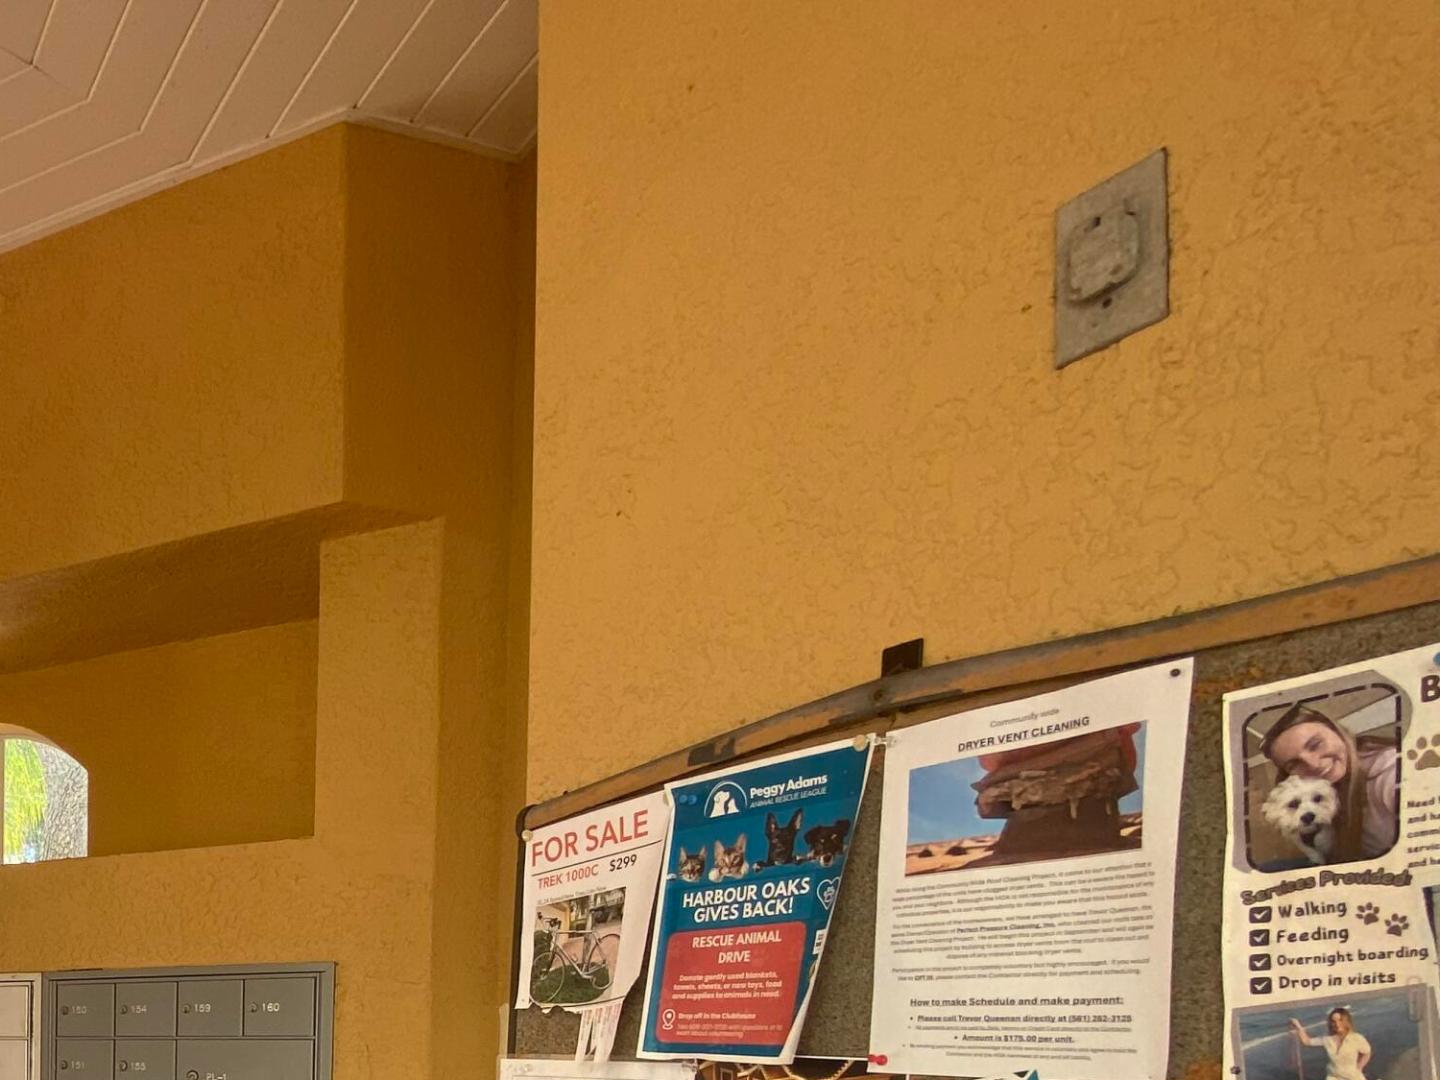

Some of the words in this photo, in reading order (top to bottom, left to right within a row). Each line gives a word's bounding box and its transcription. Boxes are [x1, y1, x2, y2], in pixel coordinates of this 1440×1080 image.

[958, 736, 995, 753] DRYER
[996, 730, 1028, 745] VENT
[1031, 716, 1090, 738] CLEANING
[750, 783, 785, 799] Peggy
[786, 775, 828, 791] Adams
[1407, 796, 1435, 808] Need
[531, 832, 578, 867] FOR
[585, 810, 649, 852] SALE
[609, 854, 637, 872] $299
[538, 874, 563, 890] TREK
[566, 864, 599, 882] 1000C
[683, 884, 759, 908] HARBOUR
[761, 877, 810, 896] OAKS
[1240, 876, 1316, 905] Services
[693, 904, 739, 923] GIVES
[742, 897, 794, 918] BACK!
[1278, 901, 1347, 919] Walking
[692, 934, 734, 949] RESCUE
[735, 930, 782, 946] ANIMAL
[1276, 926, 1349, 943] Feeding
[718, 950, 751, 964] DRIVE
[1277, 951, 1354, 967] Overnight
[1358, 946, 1429, 961] boarding
[1279, 976, 1322, 991] Drop
[1328, 974, 1342, 986] in
[1348, 972, 1396, 985] visits
[194, 1003, 211, 1013] 159
[262, 1002, 280, 1012] 160
[910, 998, 930, 1007] How
[931, 998, 941, 1006] to
[942, 998, 967, 1006] make
[968, 997, 1016, 1007] Schedule
[1018, 997, 1038, 1006] and
[1040, 996, 1070, 1006] make
